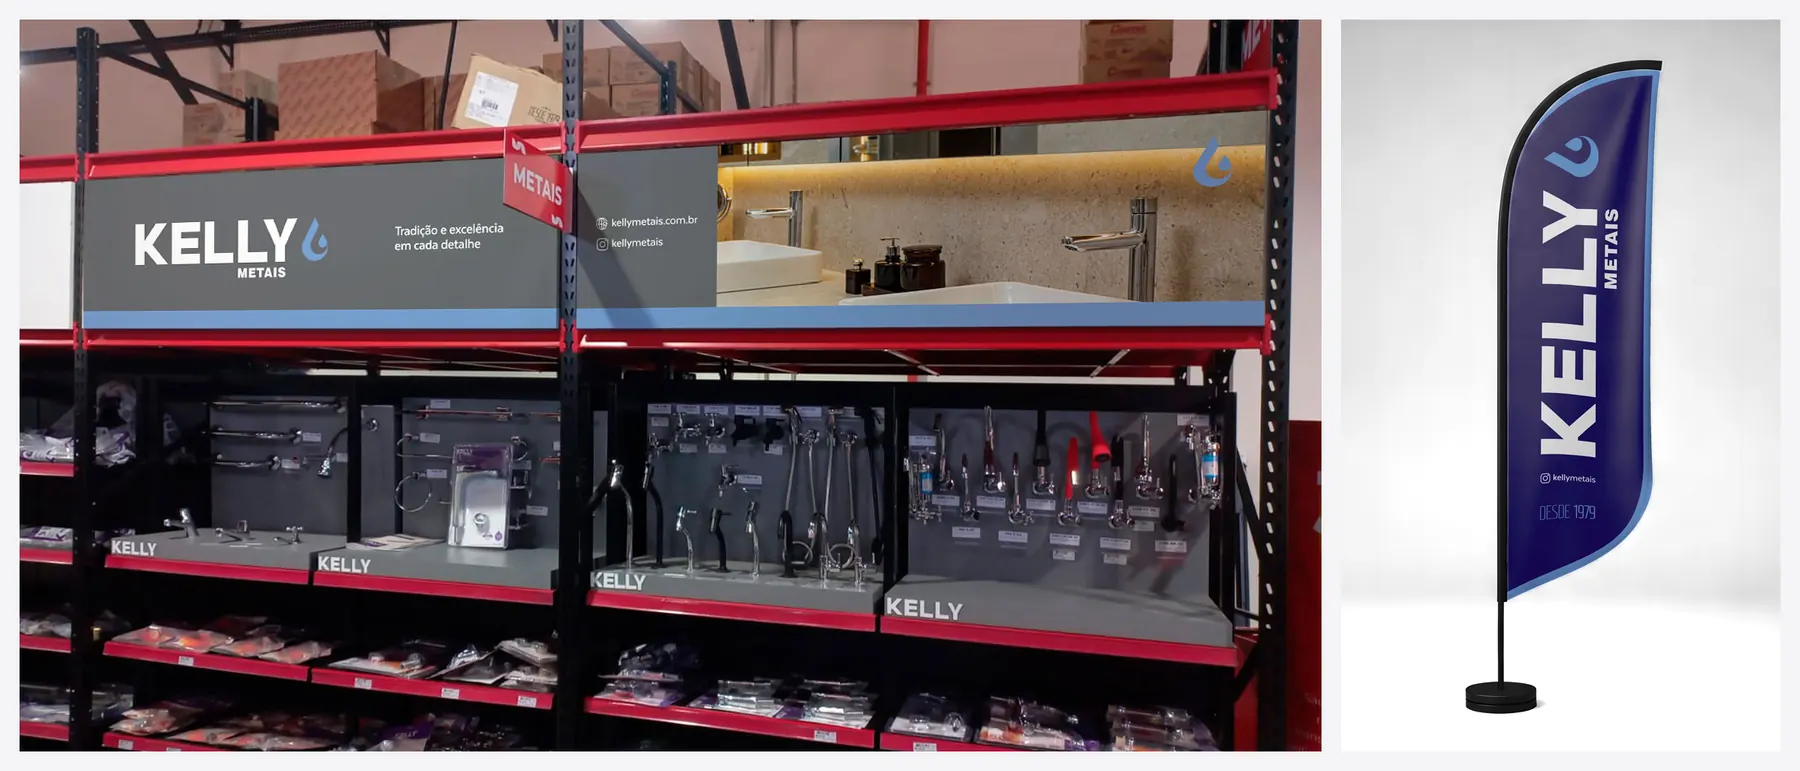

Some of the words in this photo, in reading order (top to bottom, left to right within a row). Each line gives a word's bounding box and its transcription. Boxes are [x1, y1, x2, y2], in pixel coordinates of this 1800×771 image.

[513, 162, 563, 206] METAIS
[394, 224, 438, 238] Tradição
[440, 226, 447, 235] e
[449, 222, 504, 235] excelência
[611, 215, 698, 229] kellymetais.com.br
[135, 217, 298, 266] KELLY
[394, 242, 412, 251] em
[413, 239, 439, 251] cada
[440, 238, 481, 250] detalhe
[611, 237, 663, 250] kellymetais
[1604, 208, 1620, 290] METAIS
[237, 267, 286, 279] METAIS
[1540, 190, 1598, 458] KELLY
[1552, 473, 1597, 484] kellymetais
[1539, 504, 1571, 521] DESDE
[1573, 504, 1596, 520] 1979
[111, 539, 157, 557] KELLY
[318, 555, 371, 574] KELLY
[590, 571, 647, 591] KELLY
[886, 597, 963, 621] KELLY
